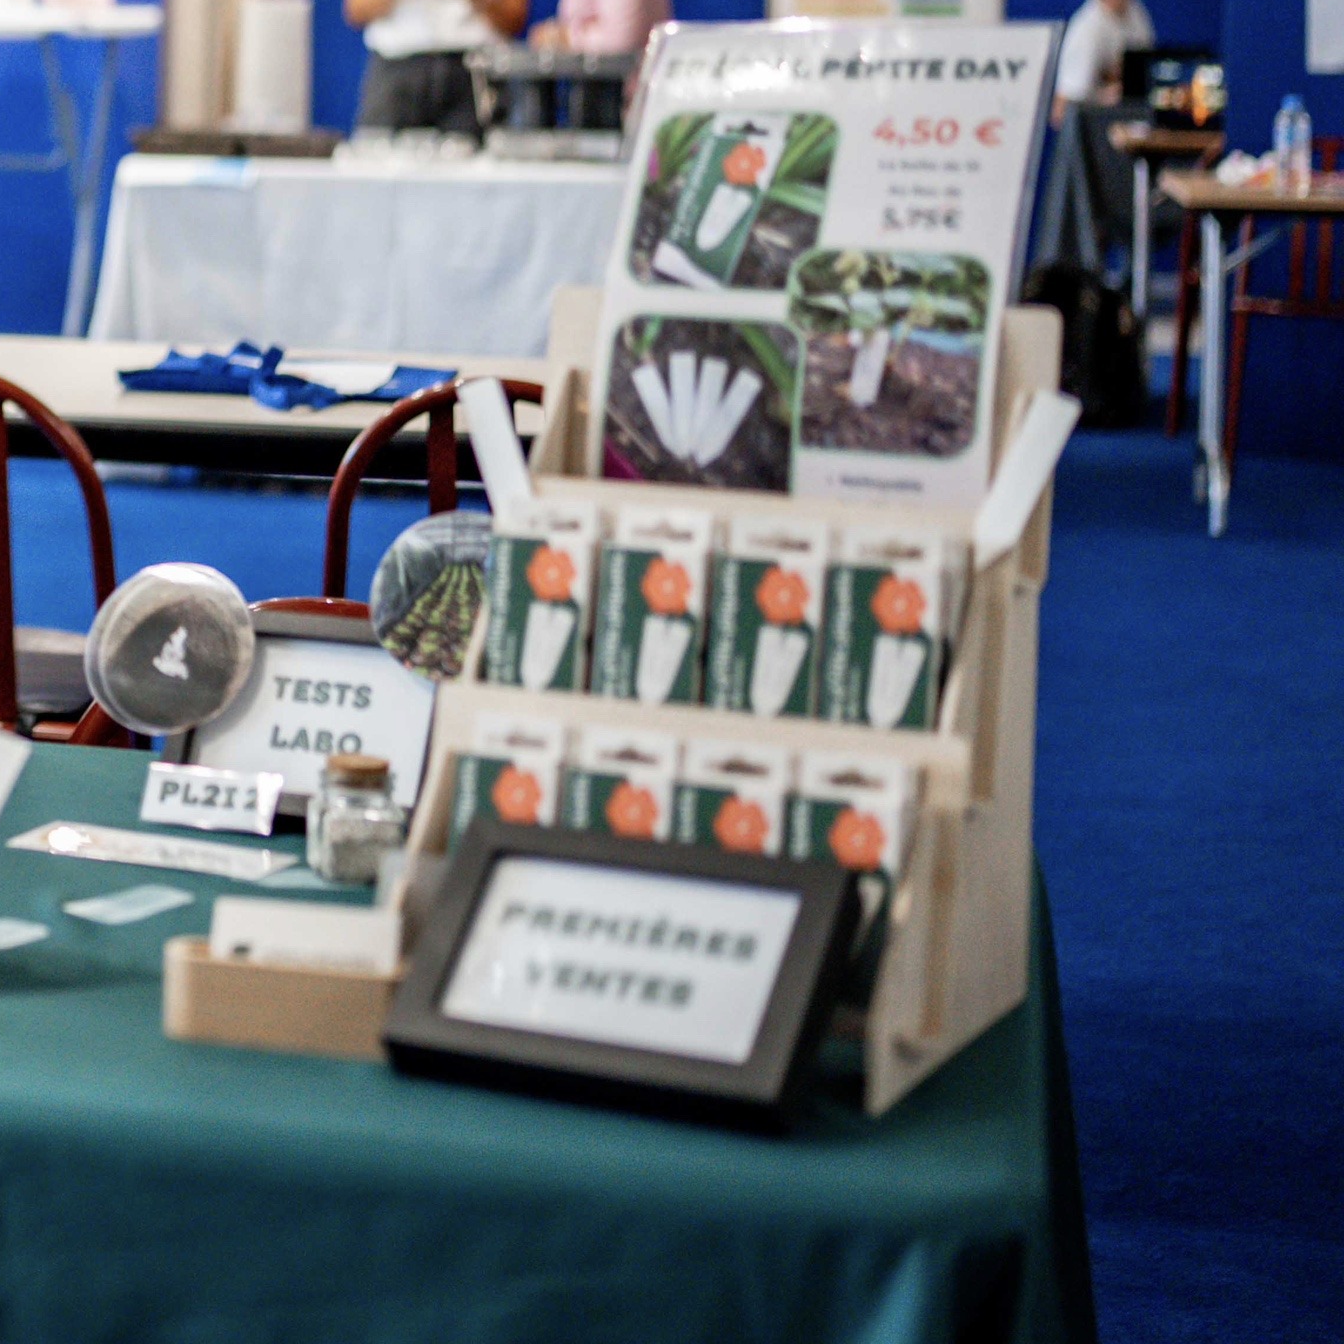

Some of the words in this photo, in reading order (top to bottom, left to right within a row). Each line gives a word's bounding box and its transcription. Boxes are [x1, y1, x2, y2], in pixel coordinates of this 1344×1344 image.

[954, 58, 1026, 81] DAY
[873, 118, 960, 147] 4,50
[974, 118, 1005, 147] €
[273, 675, 373, 709] TESTS
[269, 725, 363, 754] LABO
[524, 959, 695, 1009] VENTES
